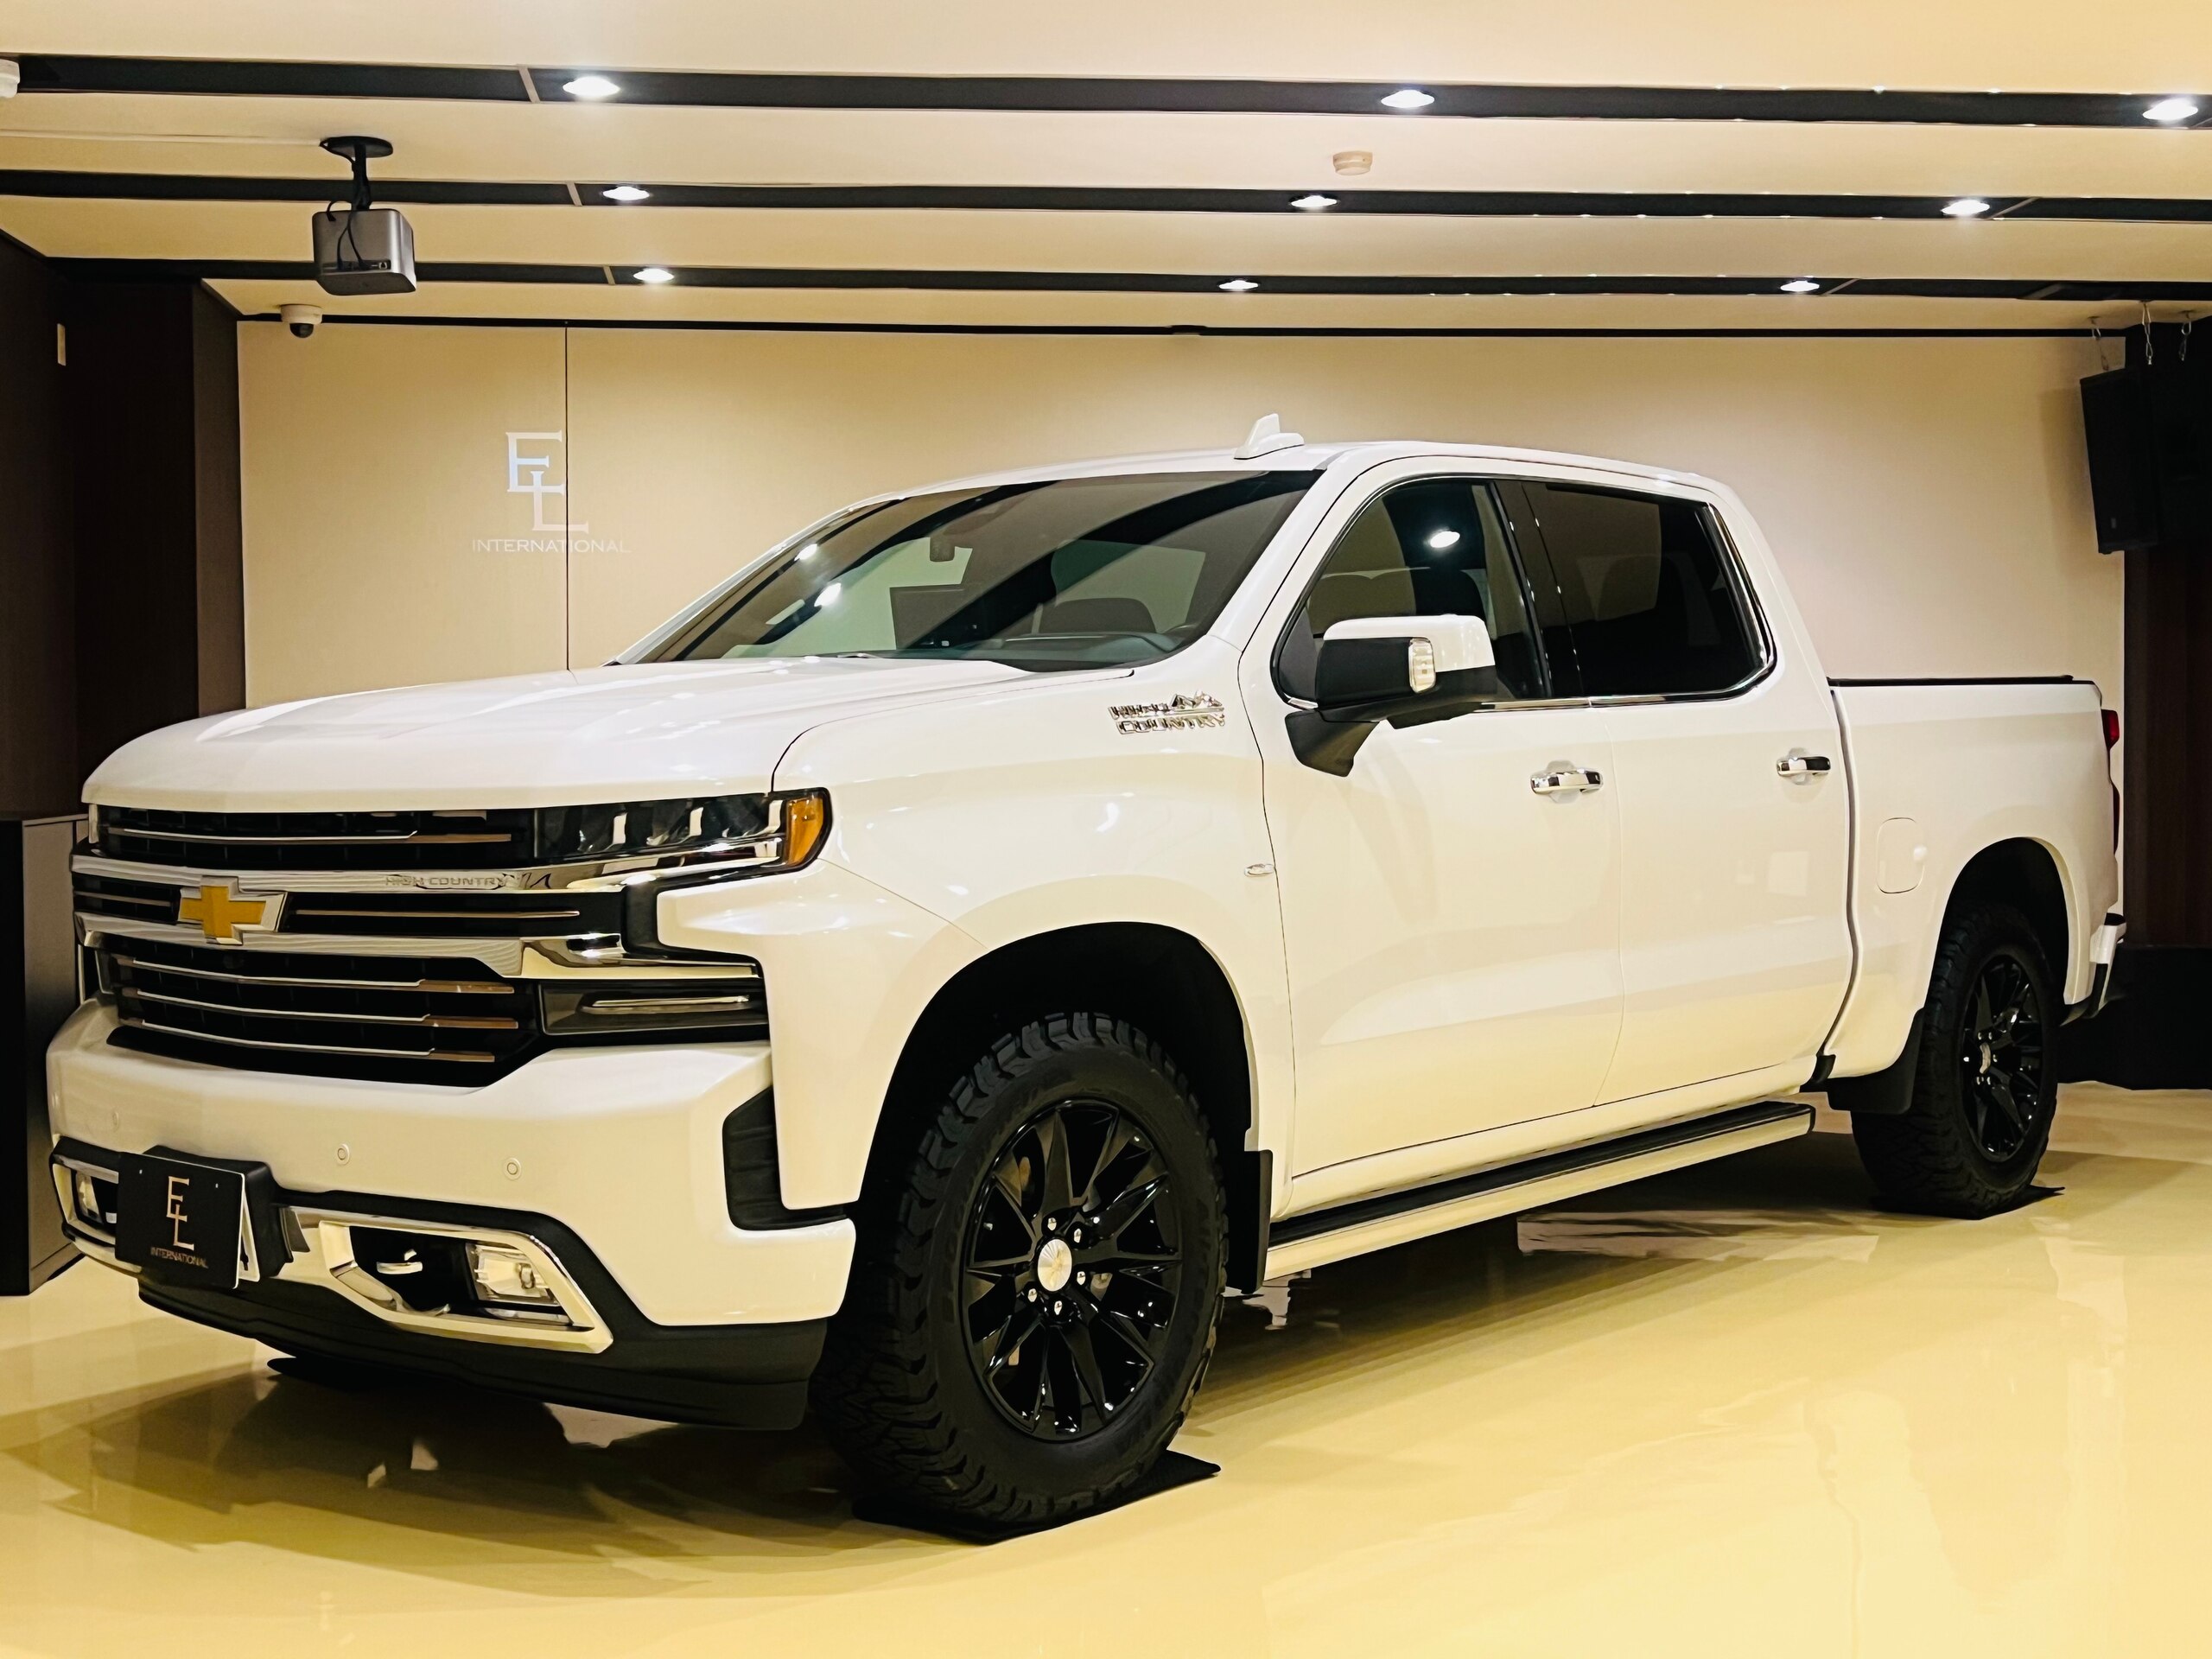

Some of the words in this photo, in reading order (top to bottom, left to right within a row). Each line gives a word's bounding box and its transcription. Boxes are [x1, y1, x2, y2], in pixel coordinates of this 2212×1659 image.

[473, 538, 632, 553] INTERNATIONAL
[1116, 713, 1225, 735] COUNTRY
[385, 875, 425, 887] HIGH
[429, 876, 505, 887] COUNTRY
[150, 1246, 210, 1269] INTERNATIONAL
